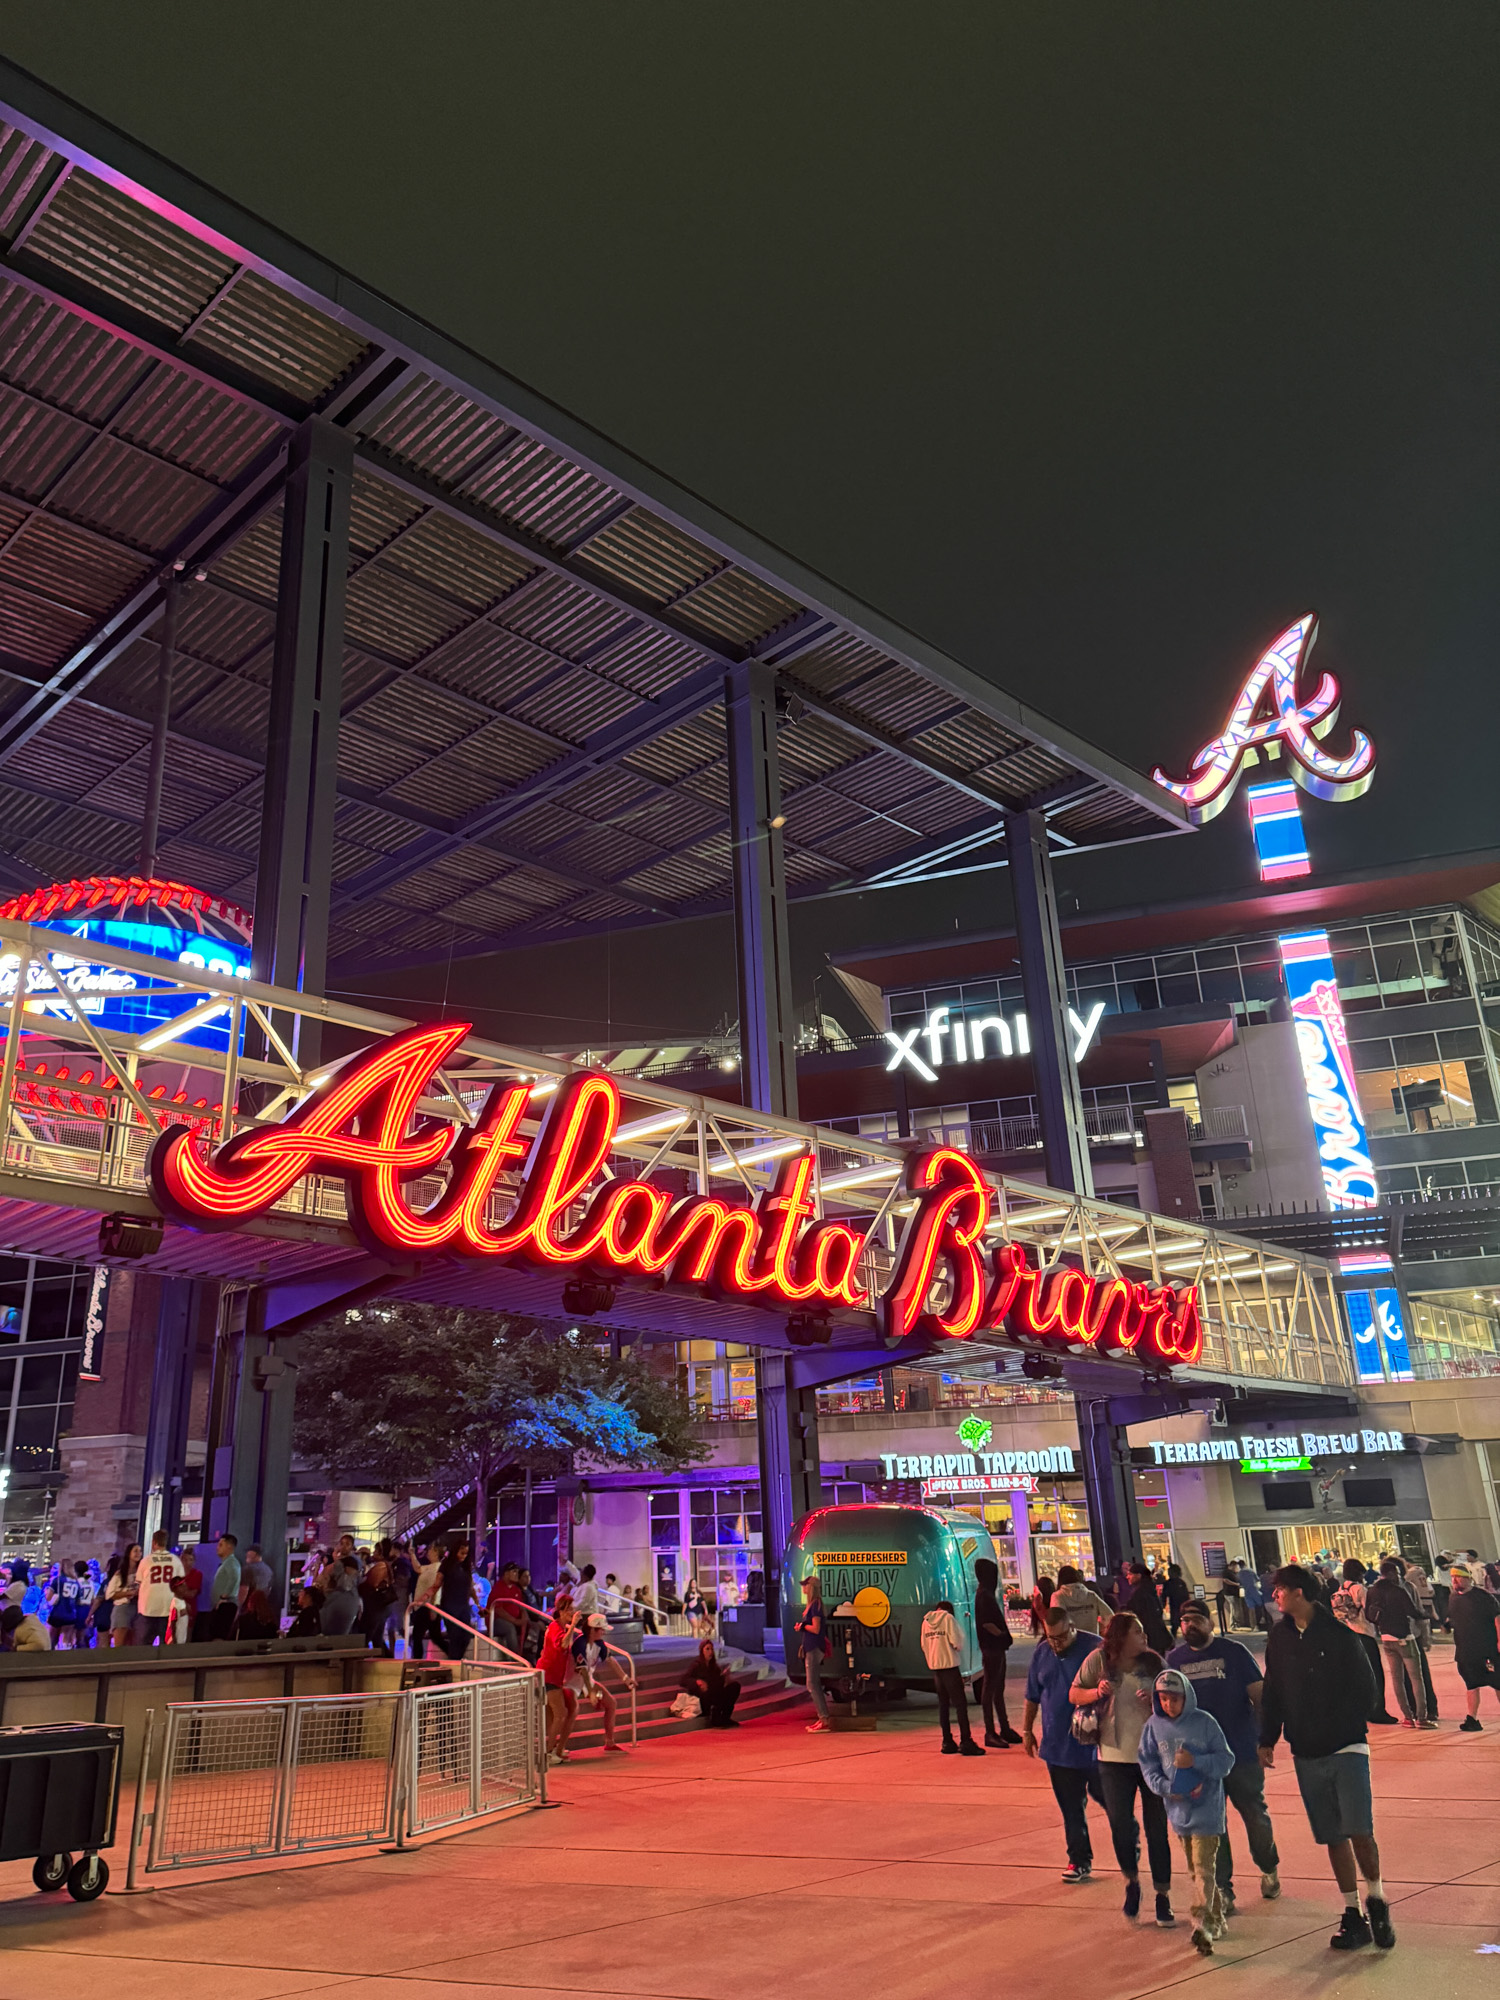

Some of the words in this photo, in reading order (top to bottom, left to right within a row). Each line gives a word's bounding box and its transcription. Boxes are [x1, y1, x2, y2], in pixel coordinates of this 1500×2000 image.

[884, 1002, 1106, 1082] xfiniy
[163, 1022, 868, 1306] Atlanta
[890, 1146, 1204, 1364] Braves
[880, 1453, 977, 1480] TERRAPIN
[978, 1446, 1075, 1475] TAPROOM
[1149, 1440, 1240, 1465] TERRAPIN
[1240, 1436, 1302, 1459] FRESH
[1300, 1433, 1358, 1456] BREW
[1360, 1429, 1406, 1453] BAR
[961, 1478, 989, 1490] BROS.
[400, 1519, 426, 1542] THIS
[428, 1498, 452, 1520] WAY
[455, 1484, 470, 1500] UP
[816, 1553, 848, 1563] SPIKED
[850, 1552, 906, 1563] REFRESHERS
[62, 1580, 79, 1599] 50
[150, 1565, 174, 1584] 28
[819, 1568, 899, 1598] HAPPY
